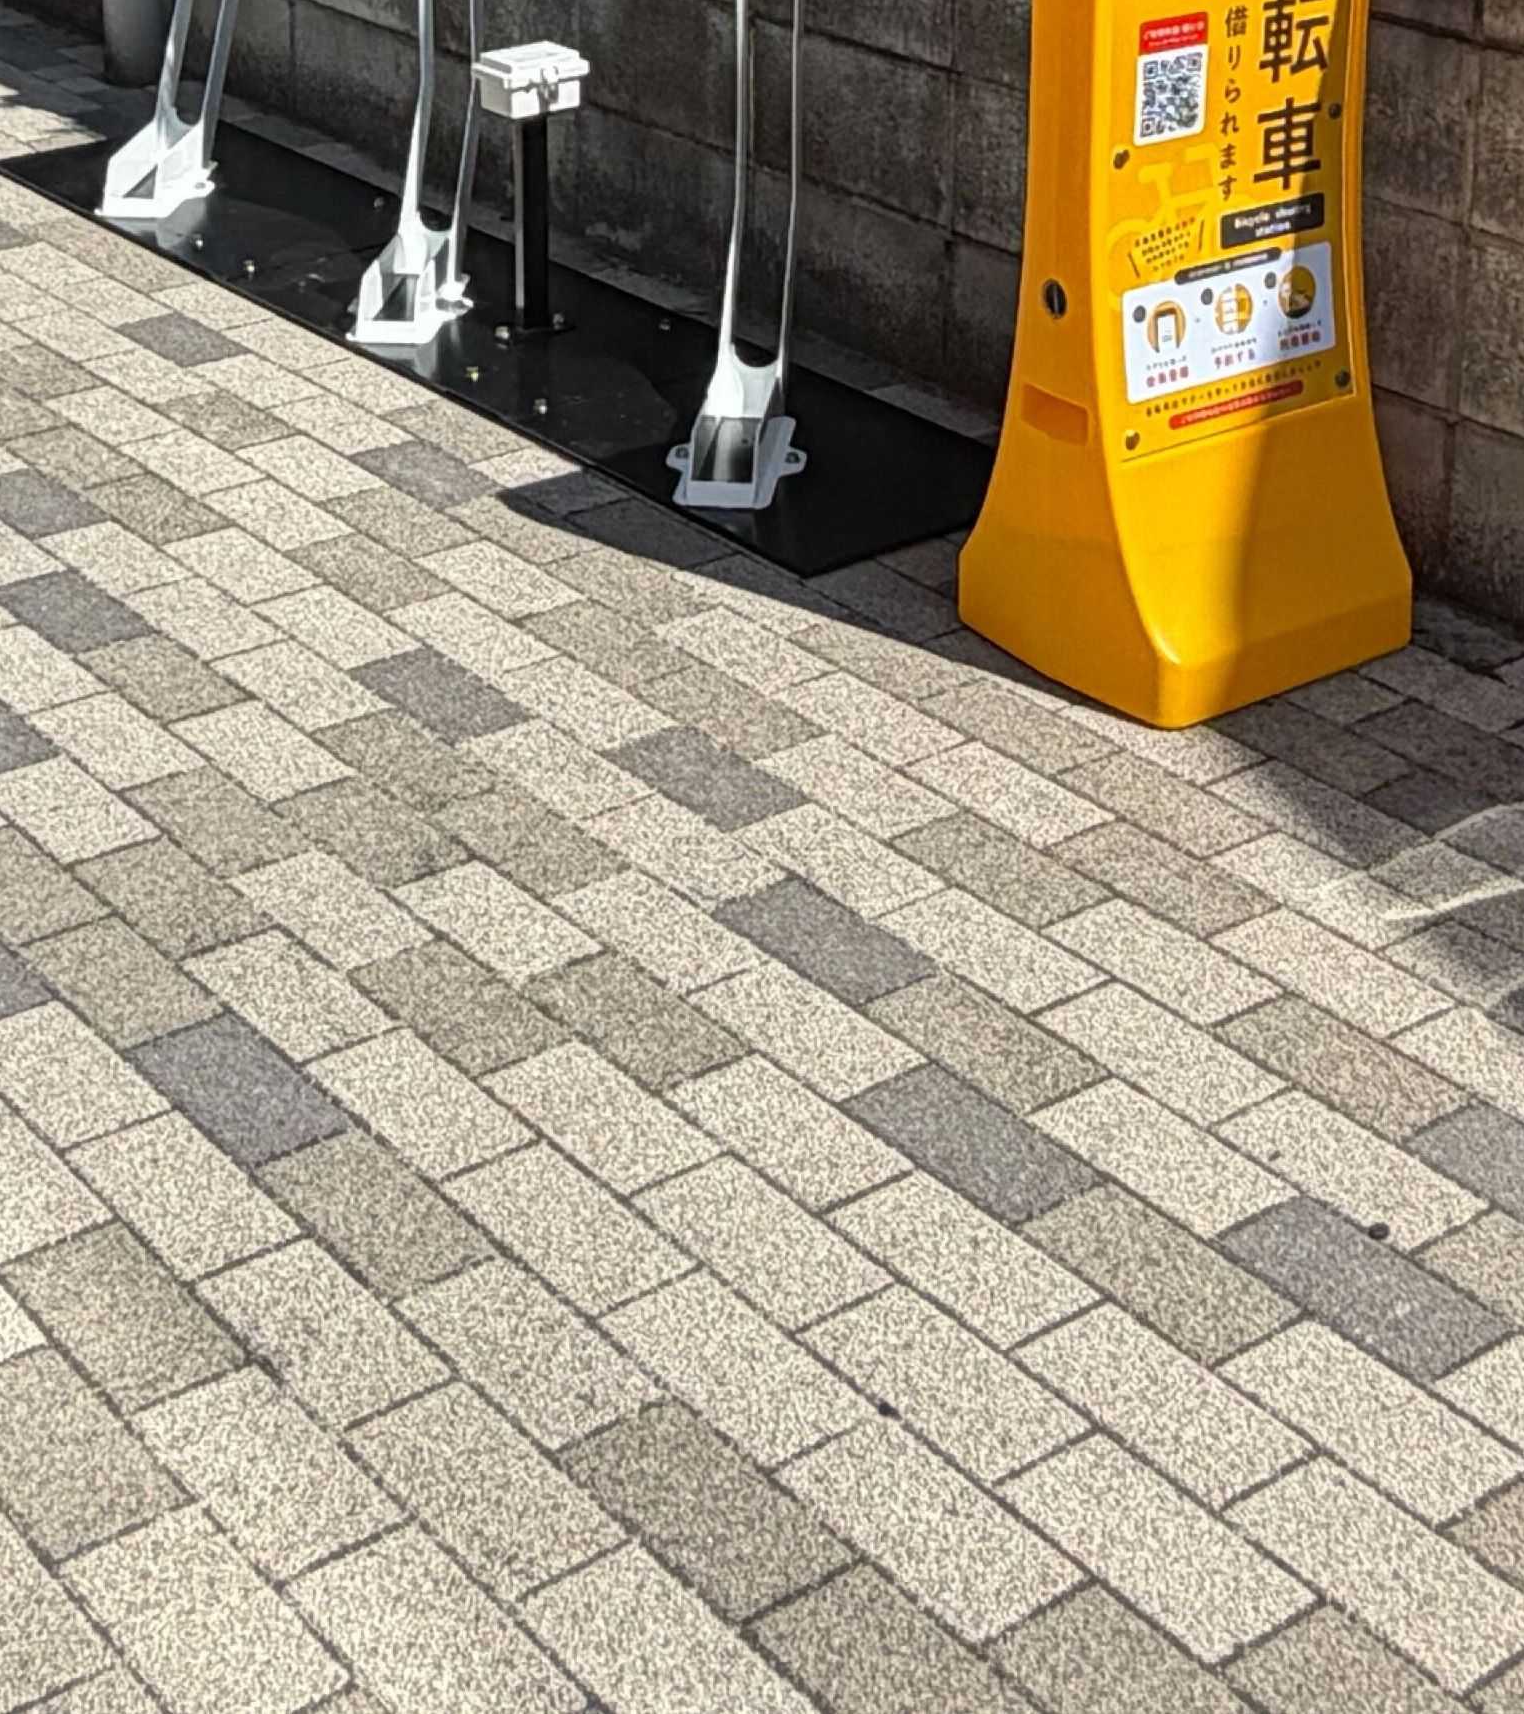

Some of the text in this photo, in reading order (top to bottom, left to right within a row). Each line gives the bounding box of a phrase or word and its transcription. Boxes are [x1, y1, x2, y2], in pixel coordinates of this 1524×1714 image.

[1218, 4, 1249, 201] 借りられます
